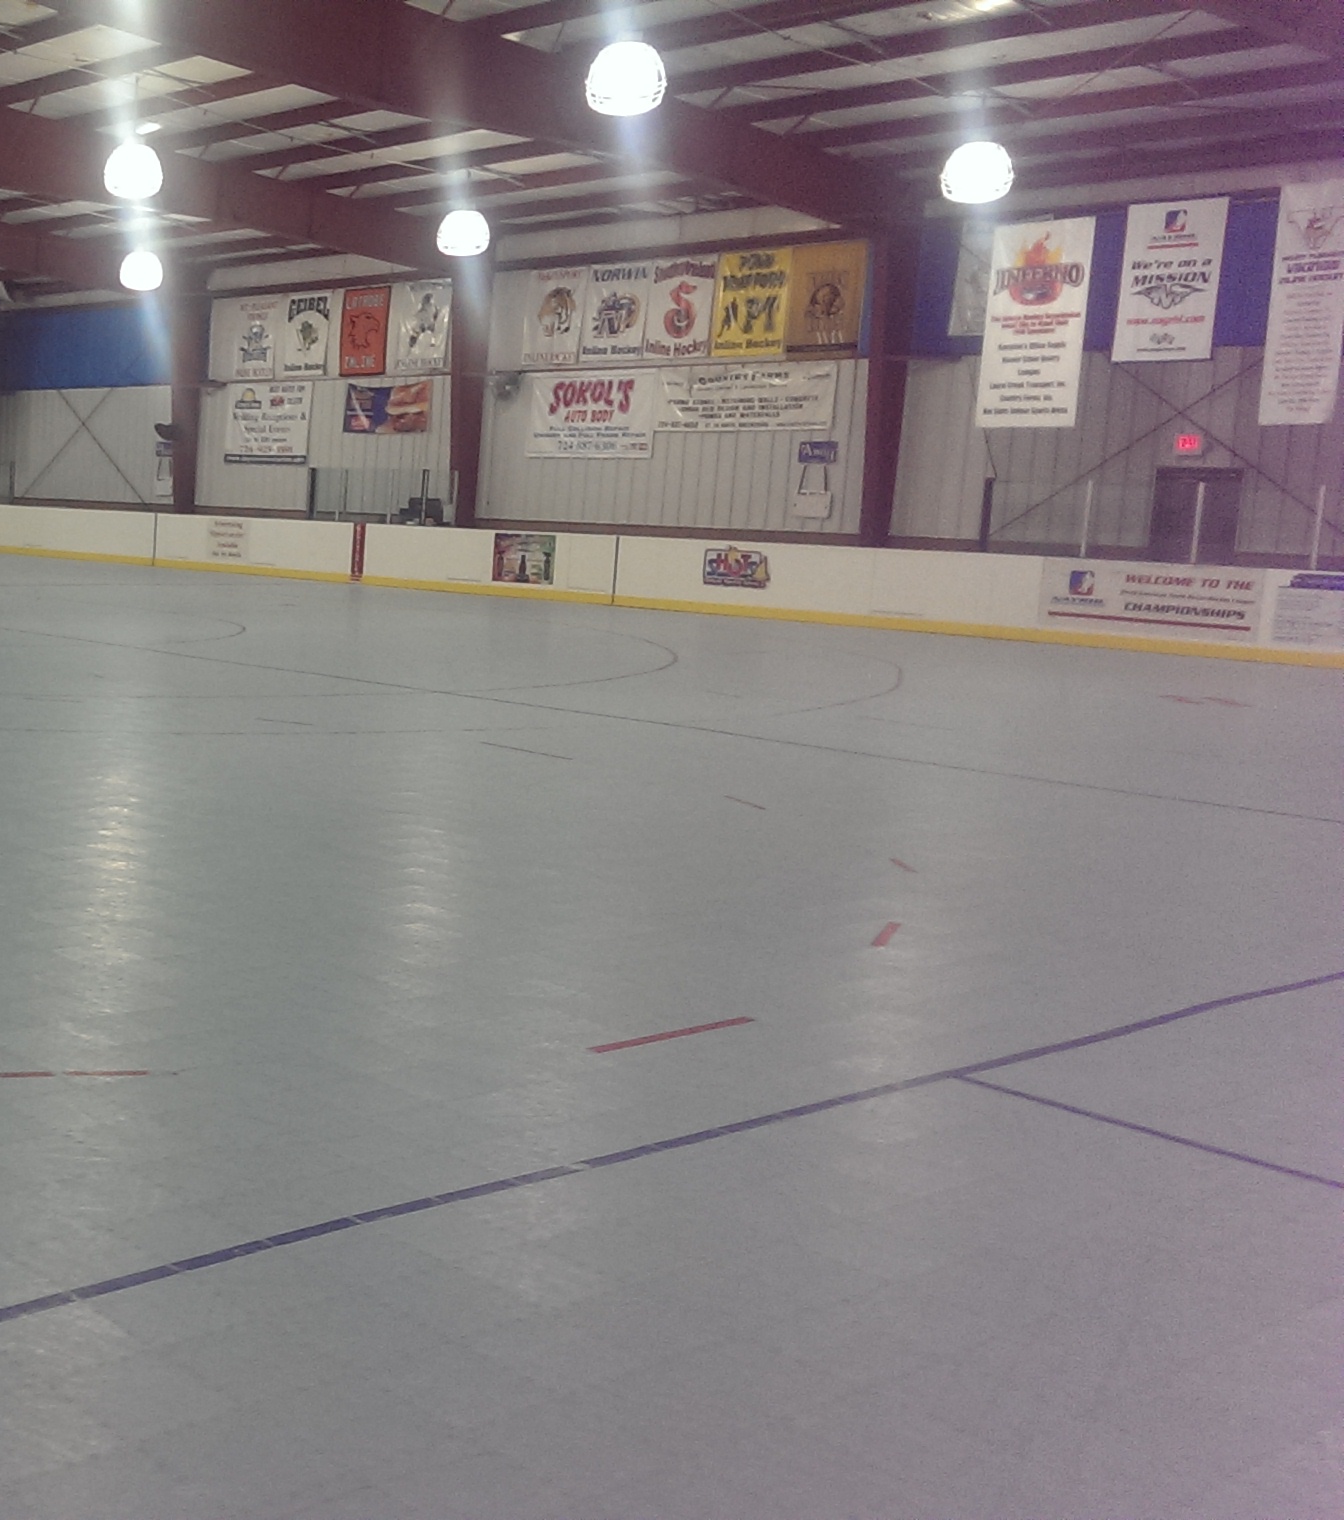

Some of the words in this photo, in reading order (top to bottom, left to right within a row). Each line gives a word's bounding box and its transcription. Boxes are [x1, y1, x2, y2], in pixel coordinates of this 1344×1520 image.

[1132, 260, 1173, 270] We're
[1178, 258, 1198, 268] on
[1202, 258, 1213, 266] a
[592, 267, 648, 282] NORWIN
[1131, 271, 1213, 288] MISSION
[287, 296, 330, 323] GEIBEL
[644, 338, 671, 356] Inline
[673, 339, 708, 356] Hockey
[549, 379, 635, 415] SOKOL'S
[563, 409, 588, 423] AUTO
[591, 409, 616, 423] BODY
[1125, 574, 1194, 588] WELCOME
[1201, 578, 1220, 589] TO
[1225, 580, 1255, 591] THE
[1124, 602, 1246, 621] CHAMPIONSHIPS
